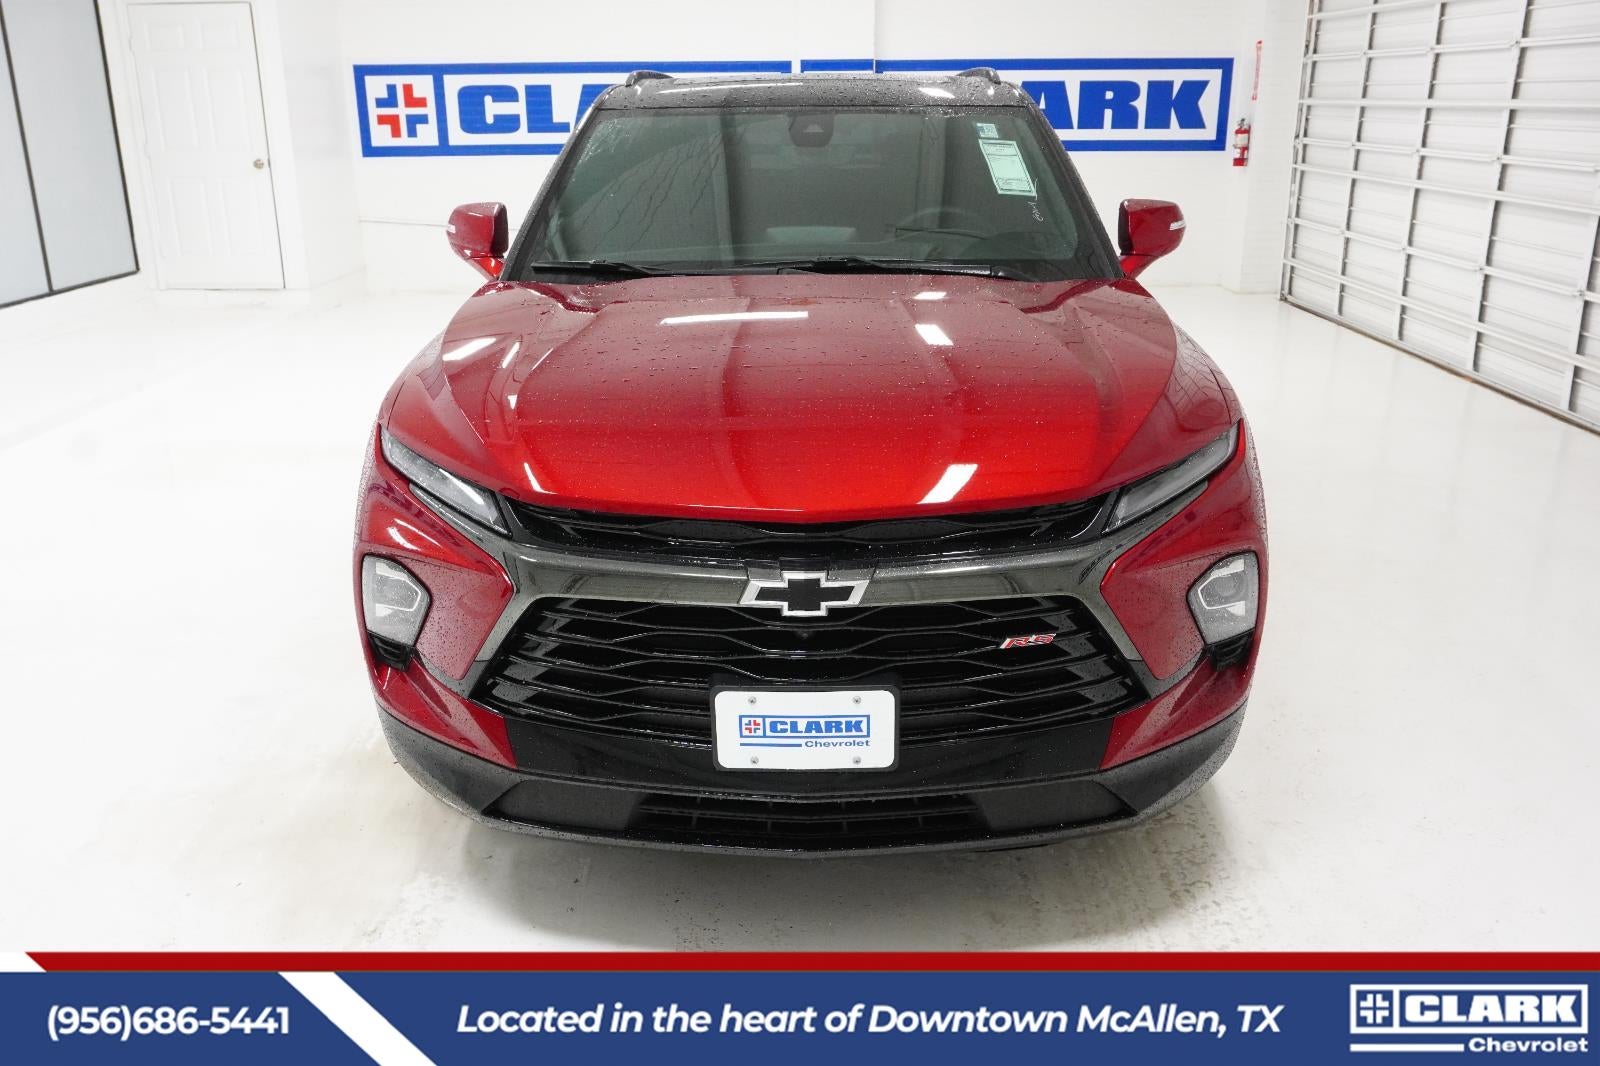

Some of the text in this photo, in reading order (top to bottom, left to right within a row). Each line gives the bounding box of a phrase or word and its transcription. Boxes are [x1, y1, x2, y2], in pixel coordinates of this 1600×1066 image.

[457, 83, 614, 134] CL
[1000, 633, 1056, 649] RS
[769, 719, 864, 734] CLARK
[804, 739, 871, 748] Chevrolet
